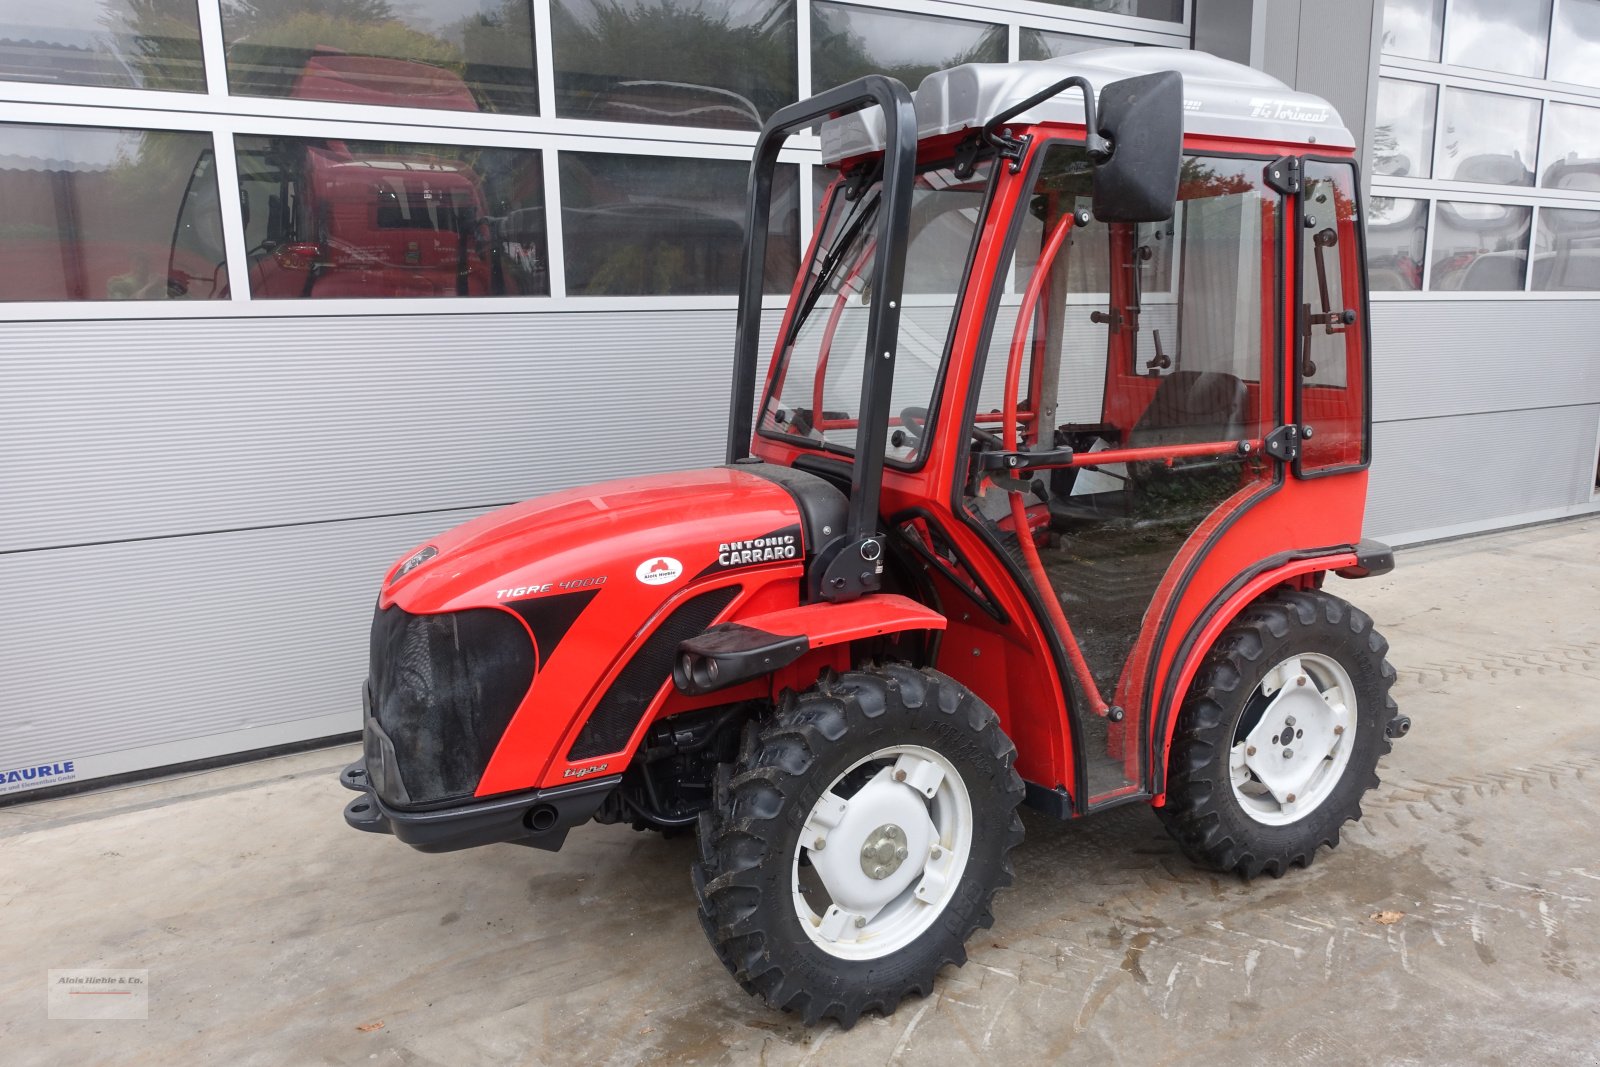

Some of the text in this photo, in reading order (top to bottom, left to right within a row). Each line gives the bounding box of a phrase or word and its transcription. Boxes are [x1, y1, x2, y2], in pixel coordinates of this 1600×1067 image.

[718, 535, 795, 553] ANTONIO
[718, 545, 796, 567] CARRARO
[496, 576, 607, 599] TIGRE 4000
